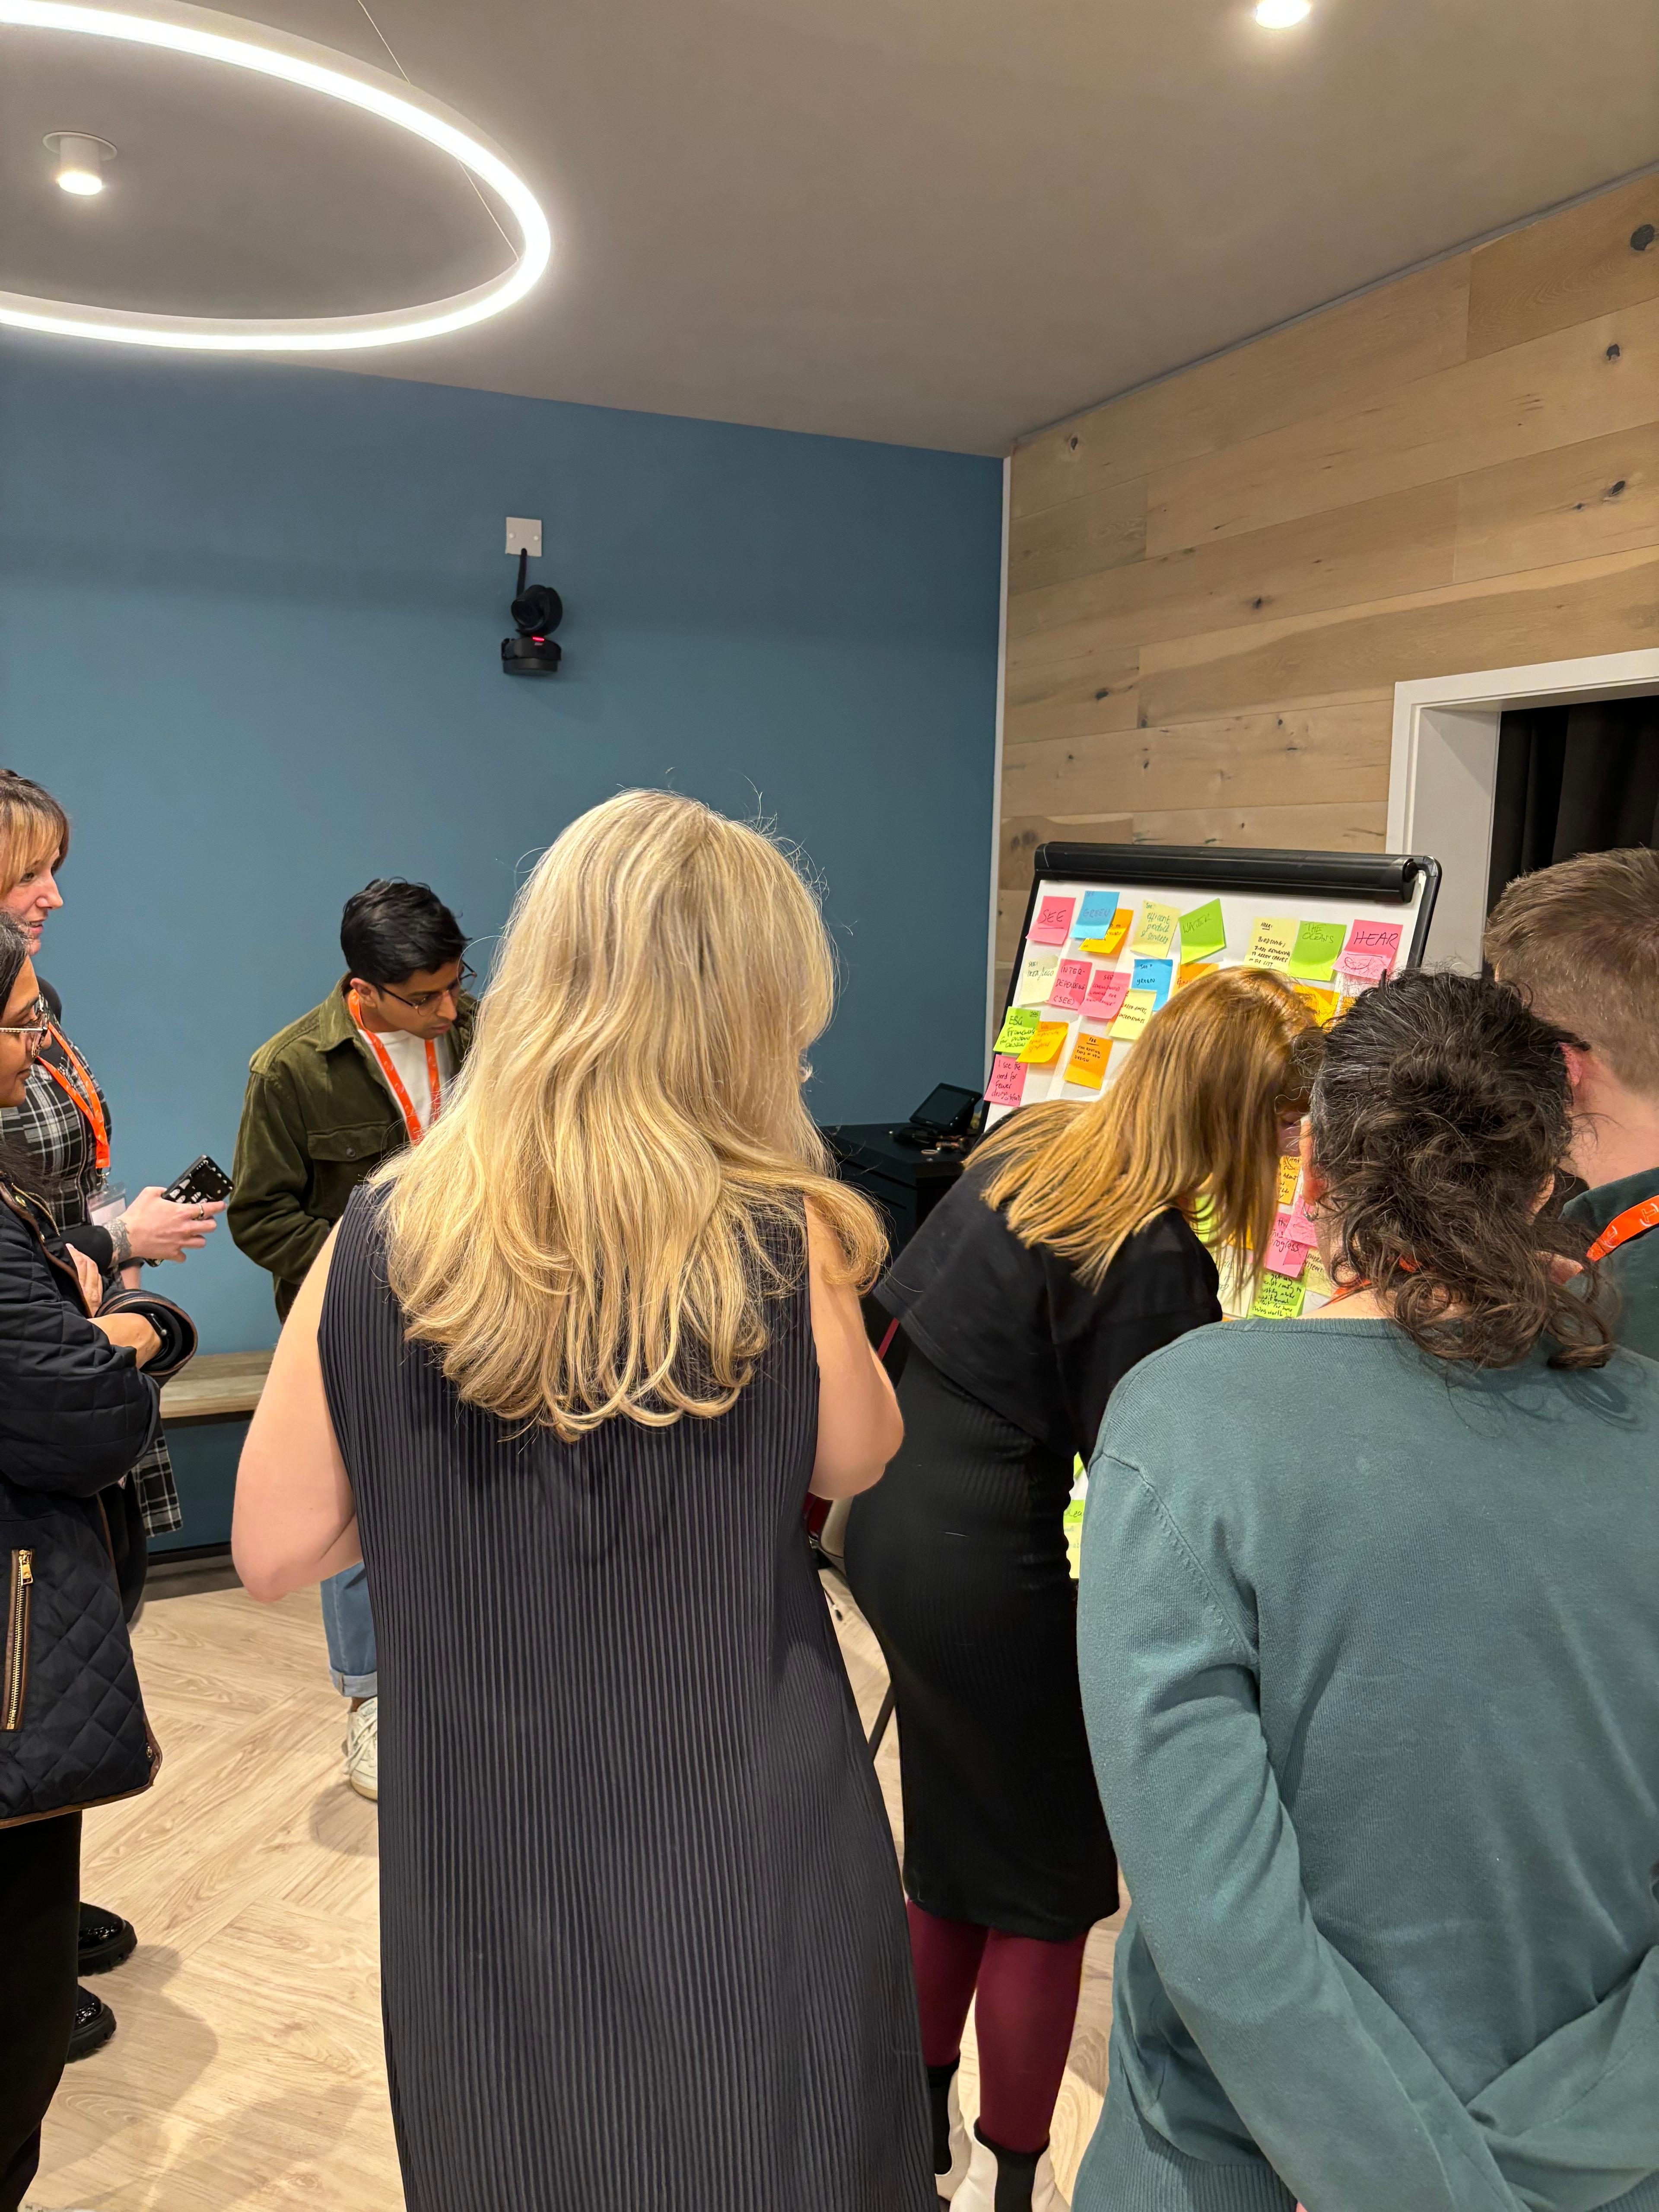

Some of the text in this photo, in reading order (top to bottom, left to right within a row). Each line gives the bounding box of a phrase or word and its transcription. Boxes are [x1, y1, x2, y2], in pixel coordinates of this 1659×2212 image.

[1038, 909, 1067, 924] SEE
[1305, 922, 1327, 932] THE
[1302, 932, 1334, 944] OCEANS
[1353, 931, 1398, 950] HEAR
[1009, 1015, 1023, 1026] ESG
